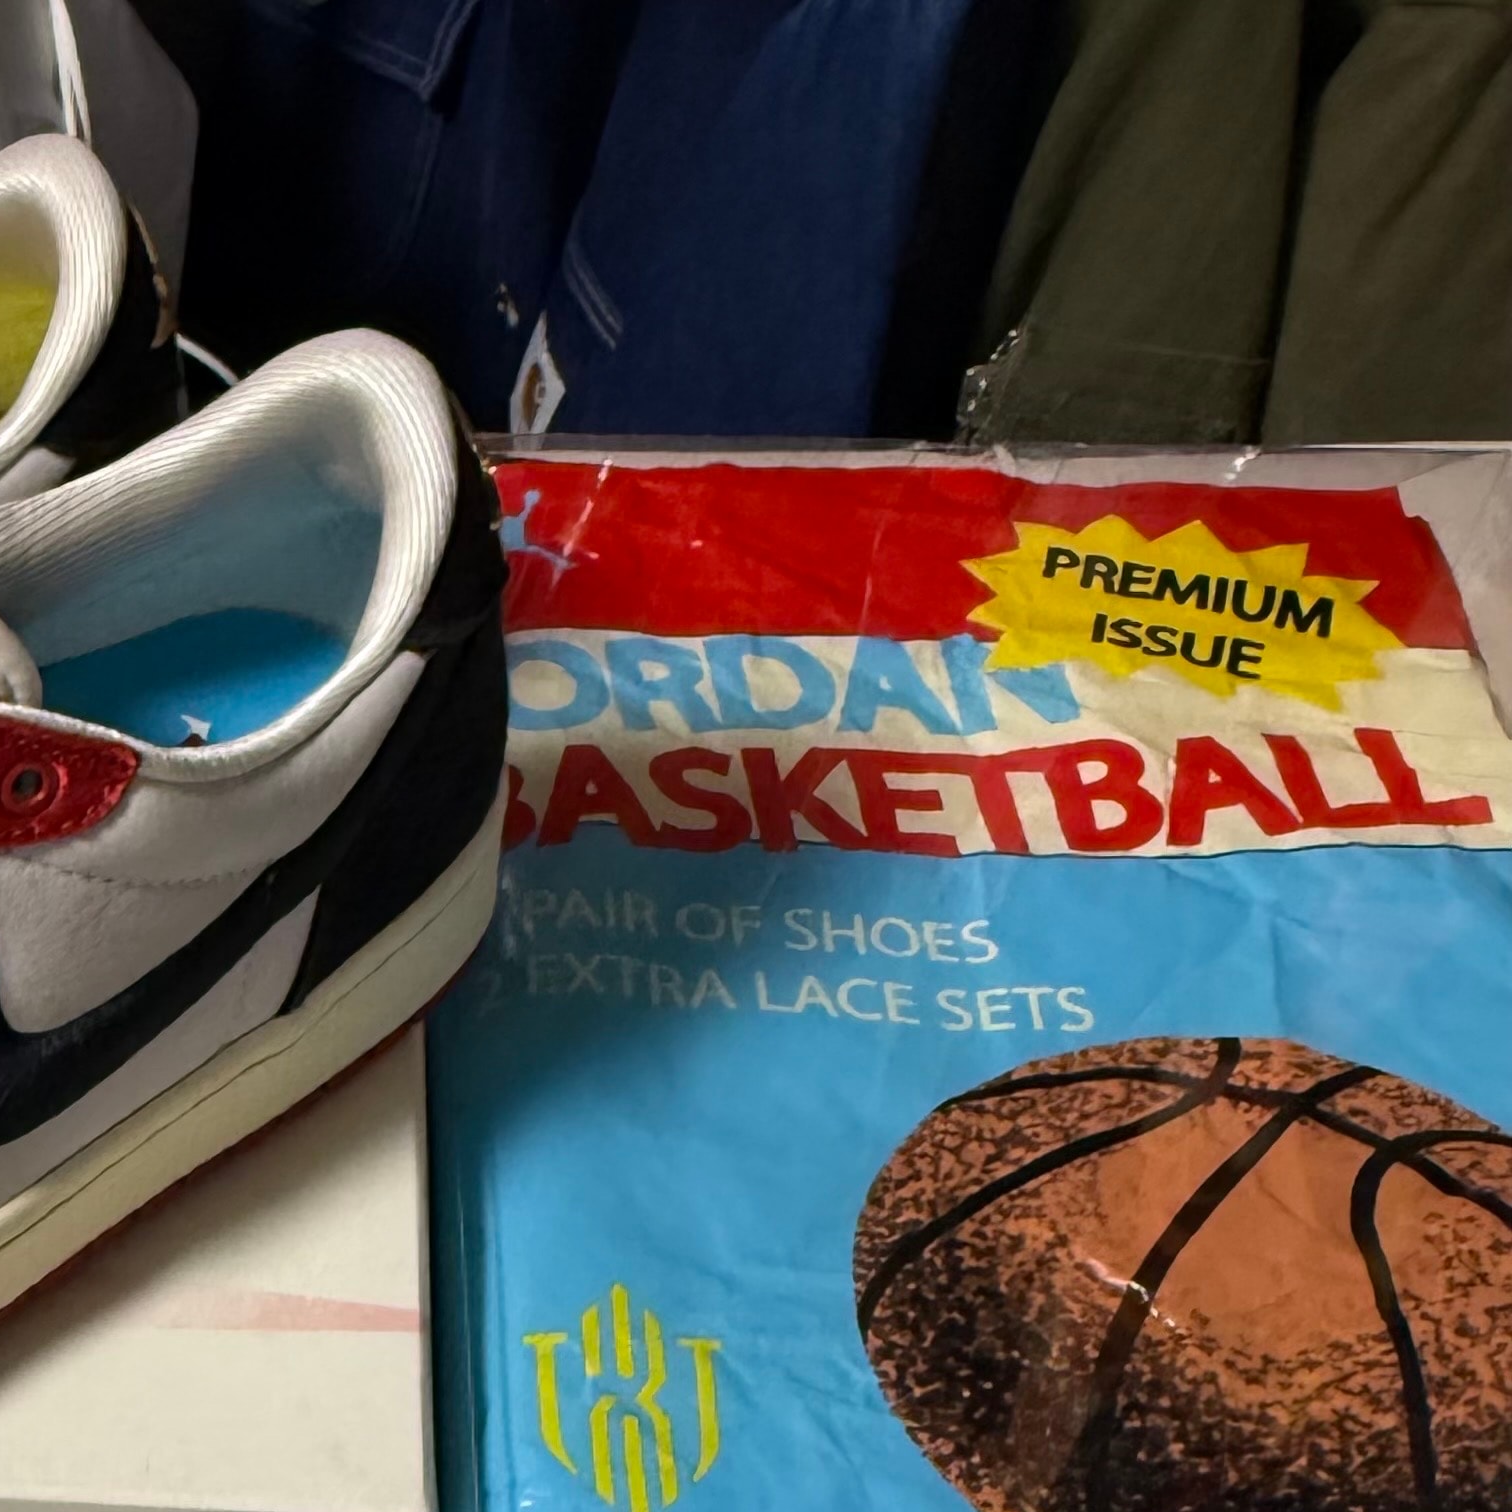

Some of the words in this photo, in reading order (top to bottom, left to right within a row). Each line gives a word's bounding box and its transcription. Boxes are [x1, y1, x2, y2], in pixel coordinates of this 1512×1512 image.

[1042, 545, 1335, 639] PREMIUM
[504, 634, 1080, 735] ORDAN
[1091, 612, 1266, 680] ISSUE
[675, 903, 762, 946] OF
[782, 907, 1000, 965] SHOES
[527, 952, 737, 1010] EXTRA
[755, 970, 921, 1026] LACE
[935, 986, 1095, 1032] SETS
